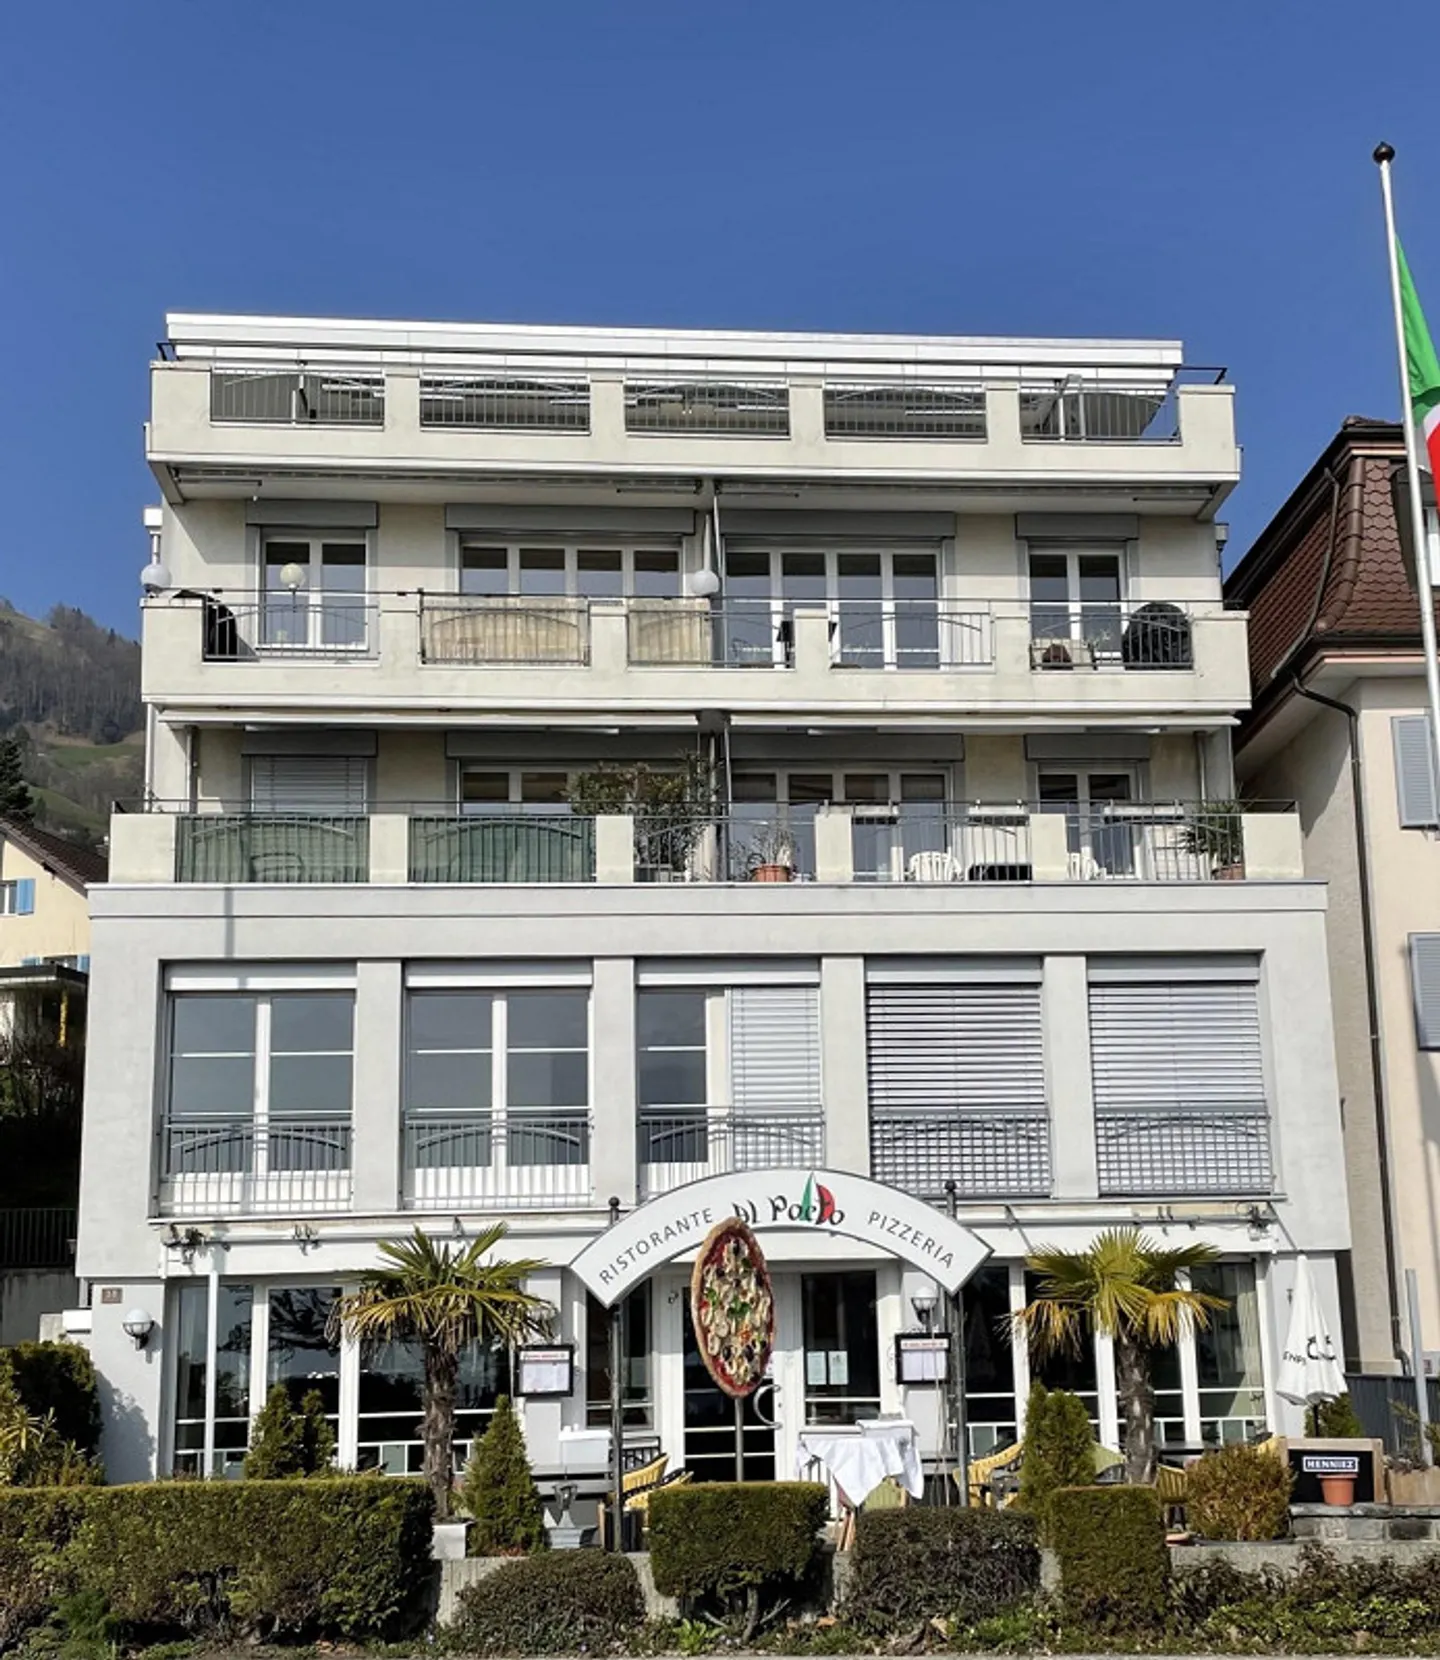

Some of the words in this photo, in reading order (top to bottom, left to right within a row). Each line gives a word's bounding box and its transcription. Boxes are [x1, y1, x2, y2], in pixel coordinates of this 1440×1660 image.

[599, 1208, 713, 1286] RISTORANTE
[767, 1195, 845, 1226] Porto
[869, 1210, 955, 1269] PIZZERIA
